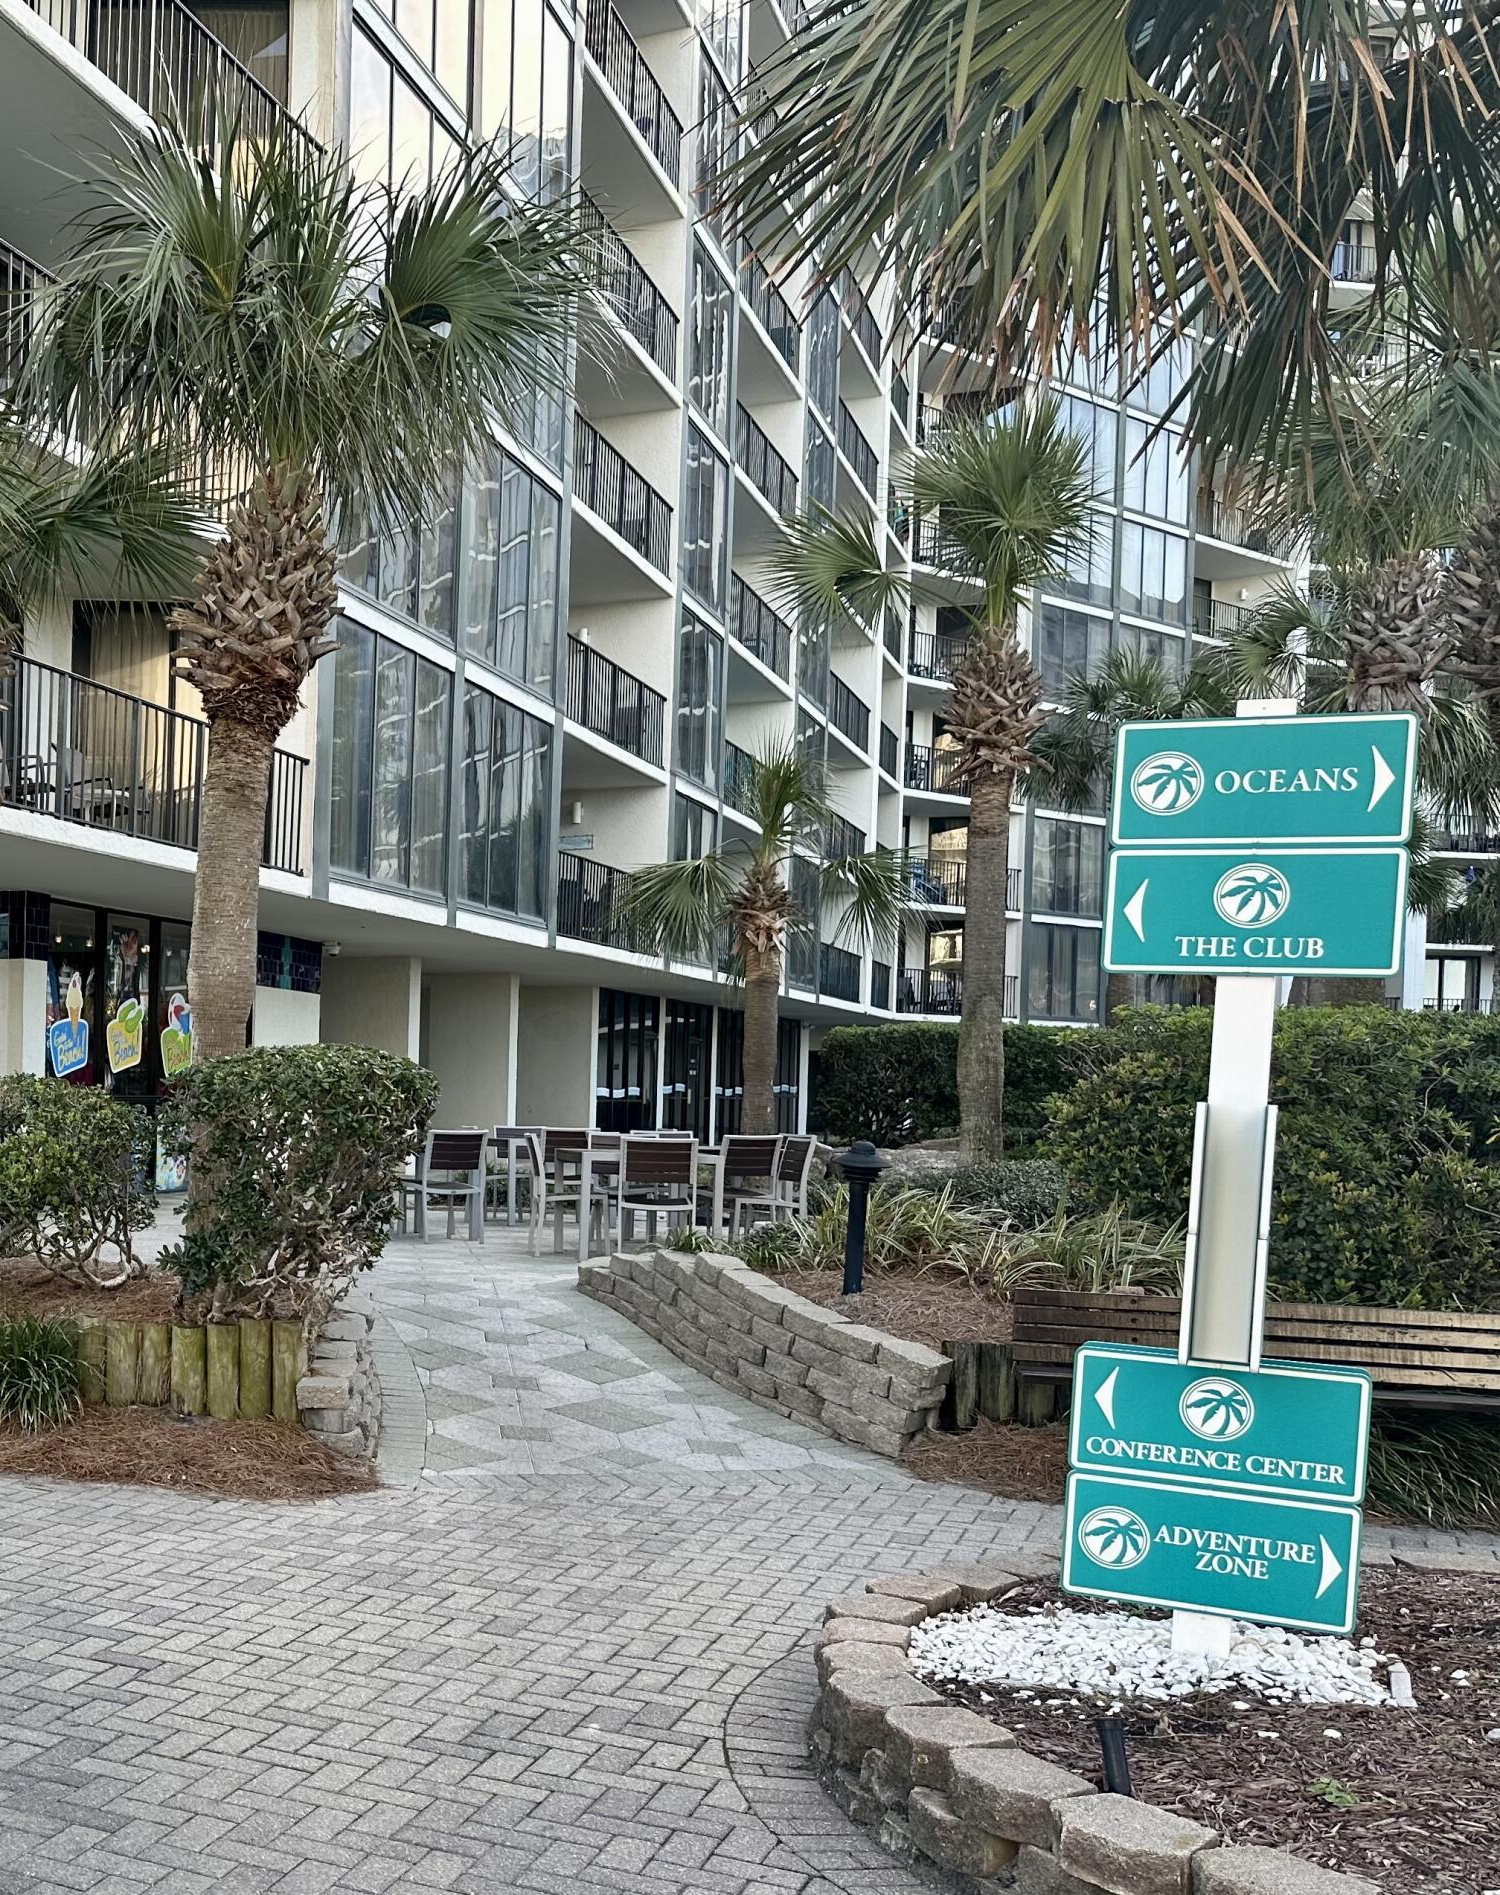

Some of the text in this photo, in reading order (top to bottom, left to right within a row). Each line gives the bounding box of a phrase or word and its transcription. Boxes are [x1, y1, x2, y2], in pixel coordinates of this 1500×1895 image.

[1214, 767, 1358, 794] OCEANS
[1174, 936, 1324, 958] THE CLUB
[1086, 1436, 1346, 1485] CONFERENCE CENTER
[1153, 1524, 1316, 1564] ADVENTURE
[1195, 1551, 1269, 1579] ZONE
